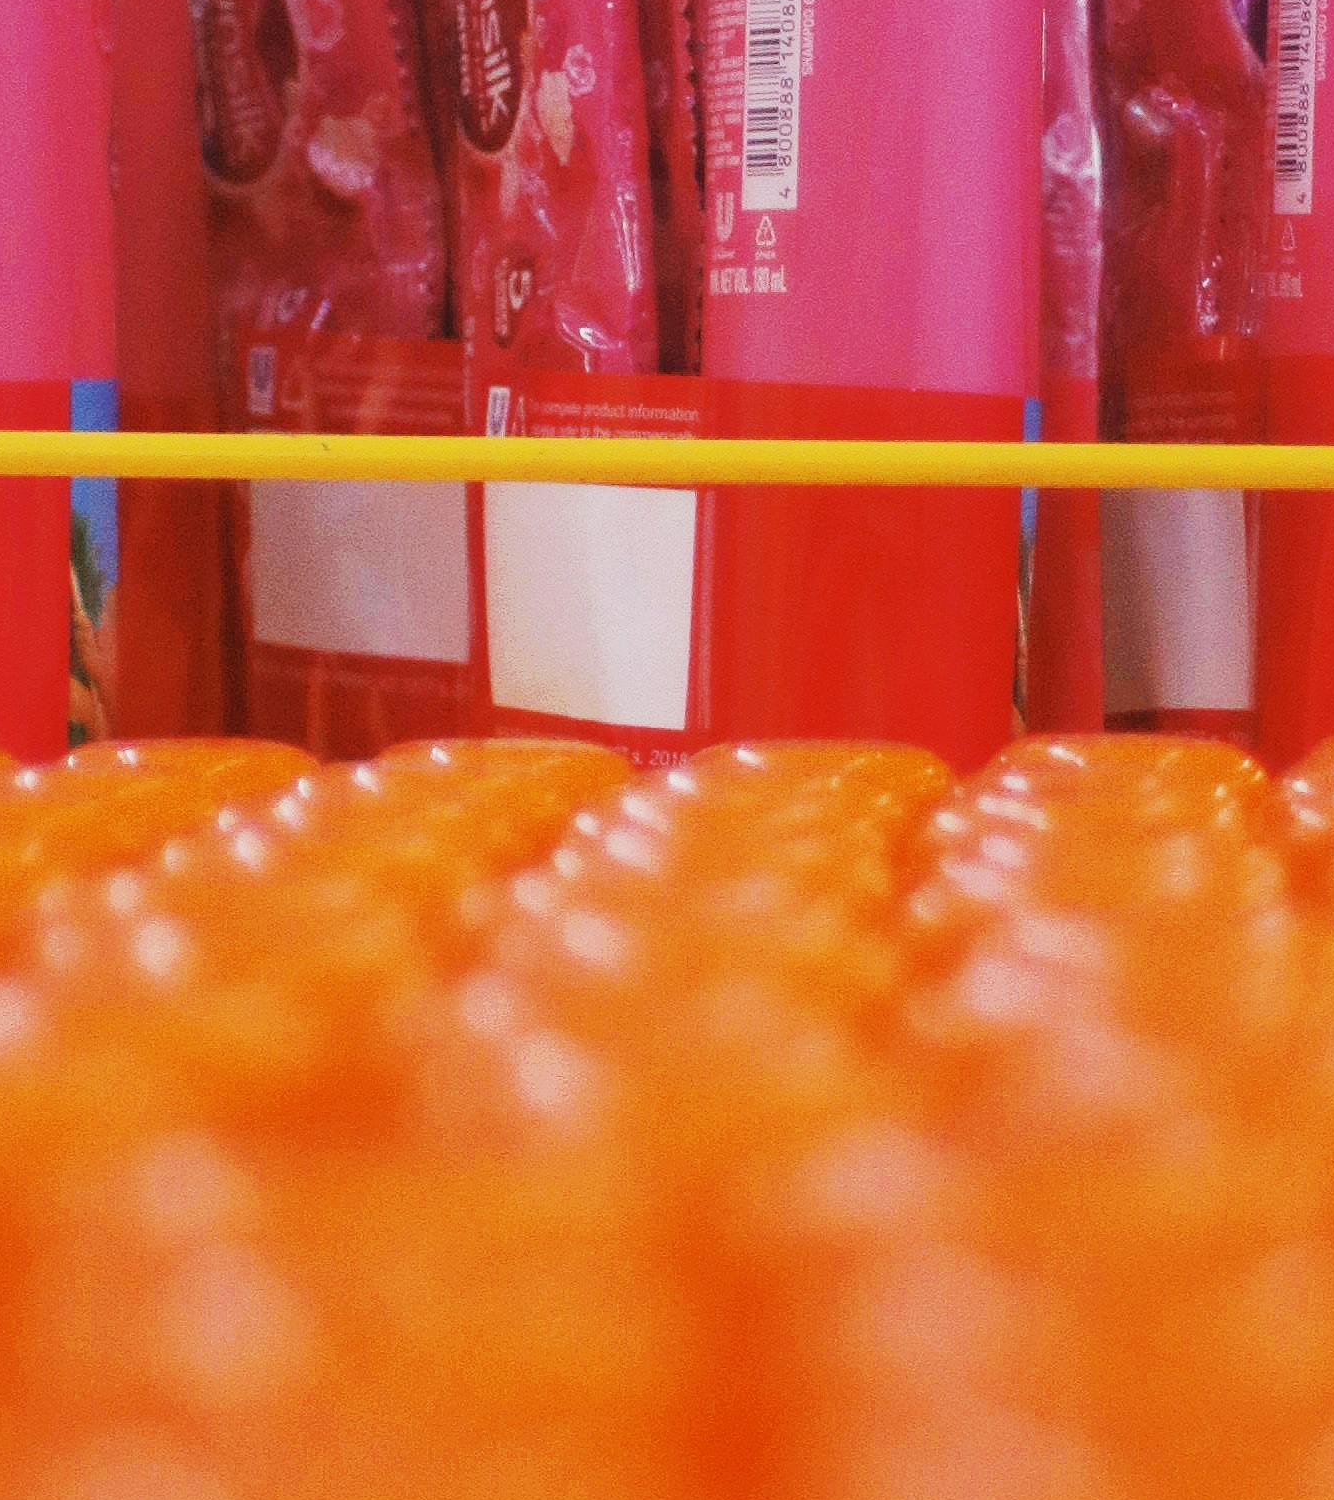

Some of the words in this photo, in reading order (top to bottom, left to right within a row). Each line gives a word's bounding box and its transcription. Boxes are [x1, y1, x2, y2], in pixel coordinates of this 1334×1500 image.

[803, 9, 815, 76] SHAMPOO
[778, 77, 794, 168] 800888
[509, 269, 533, 311] 5
[628, 403, 700, 422] information
